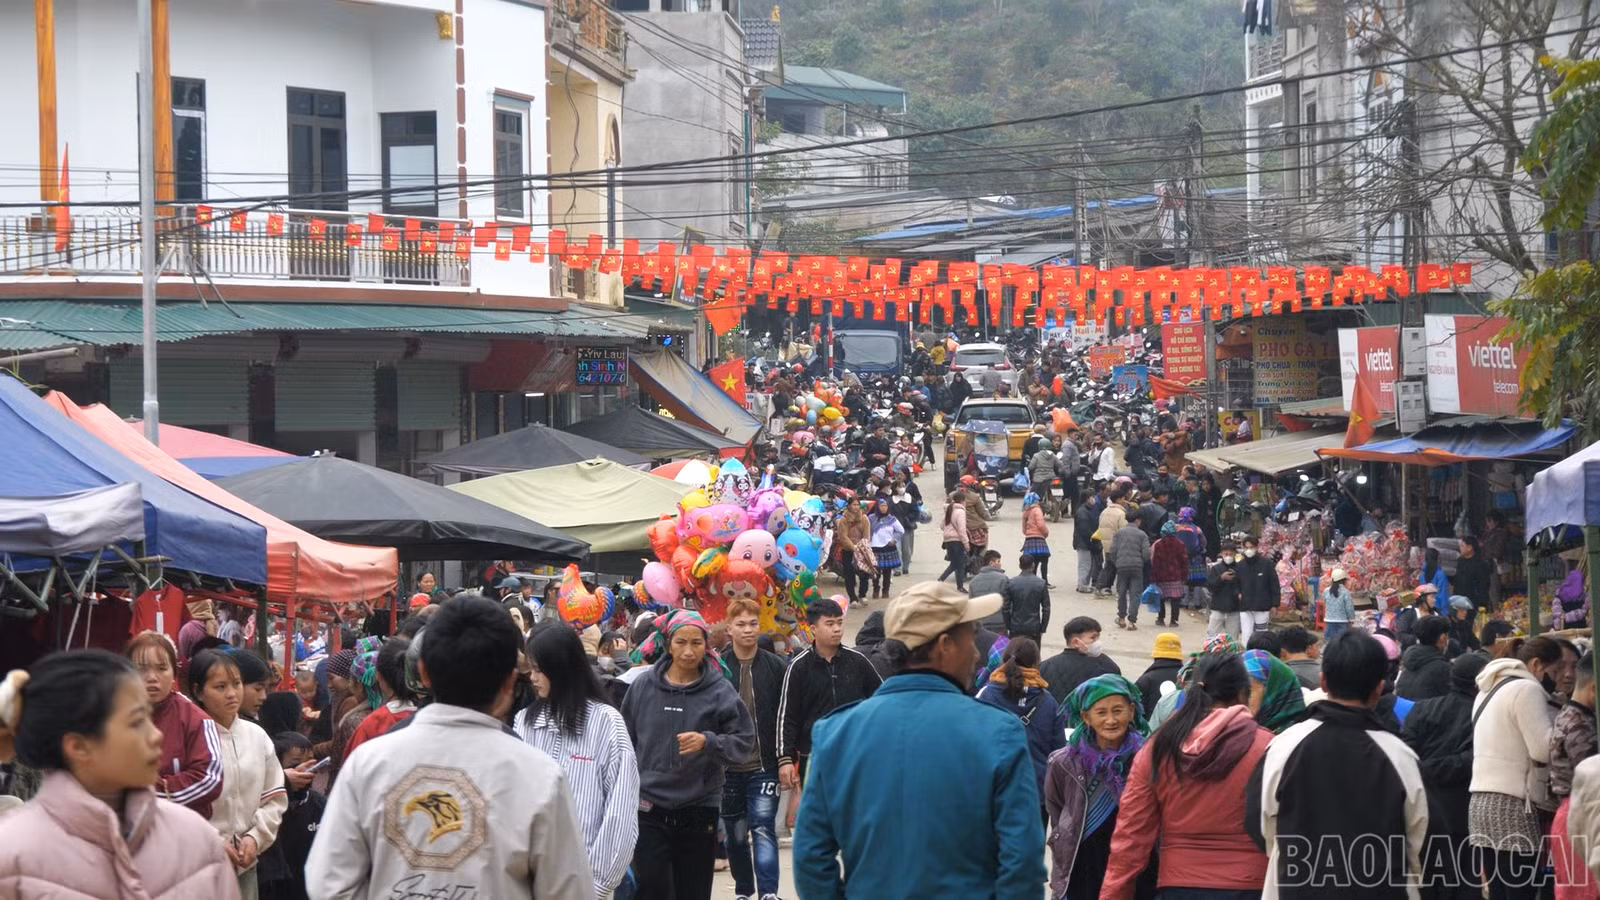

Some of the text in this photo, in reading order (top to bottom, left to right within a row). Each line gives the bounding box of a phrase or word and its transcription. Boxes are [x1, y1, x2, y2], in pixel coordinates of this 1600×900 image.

[1365, 347, 1394, 371] viettel
[1468, 340, 1517, 369] viettel
[592, 361, 614, 371] Sinh
[1493, 379, 1519, 395] telecom
